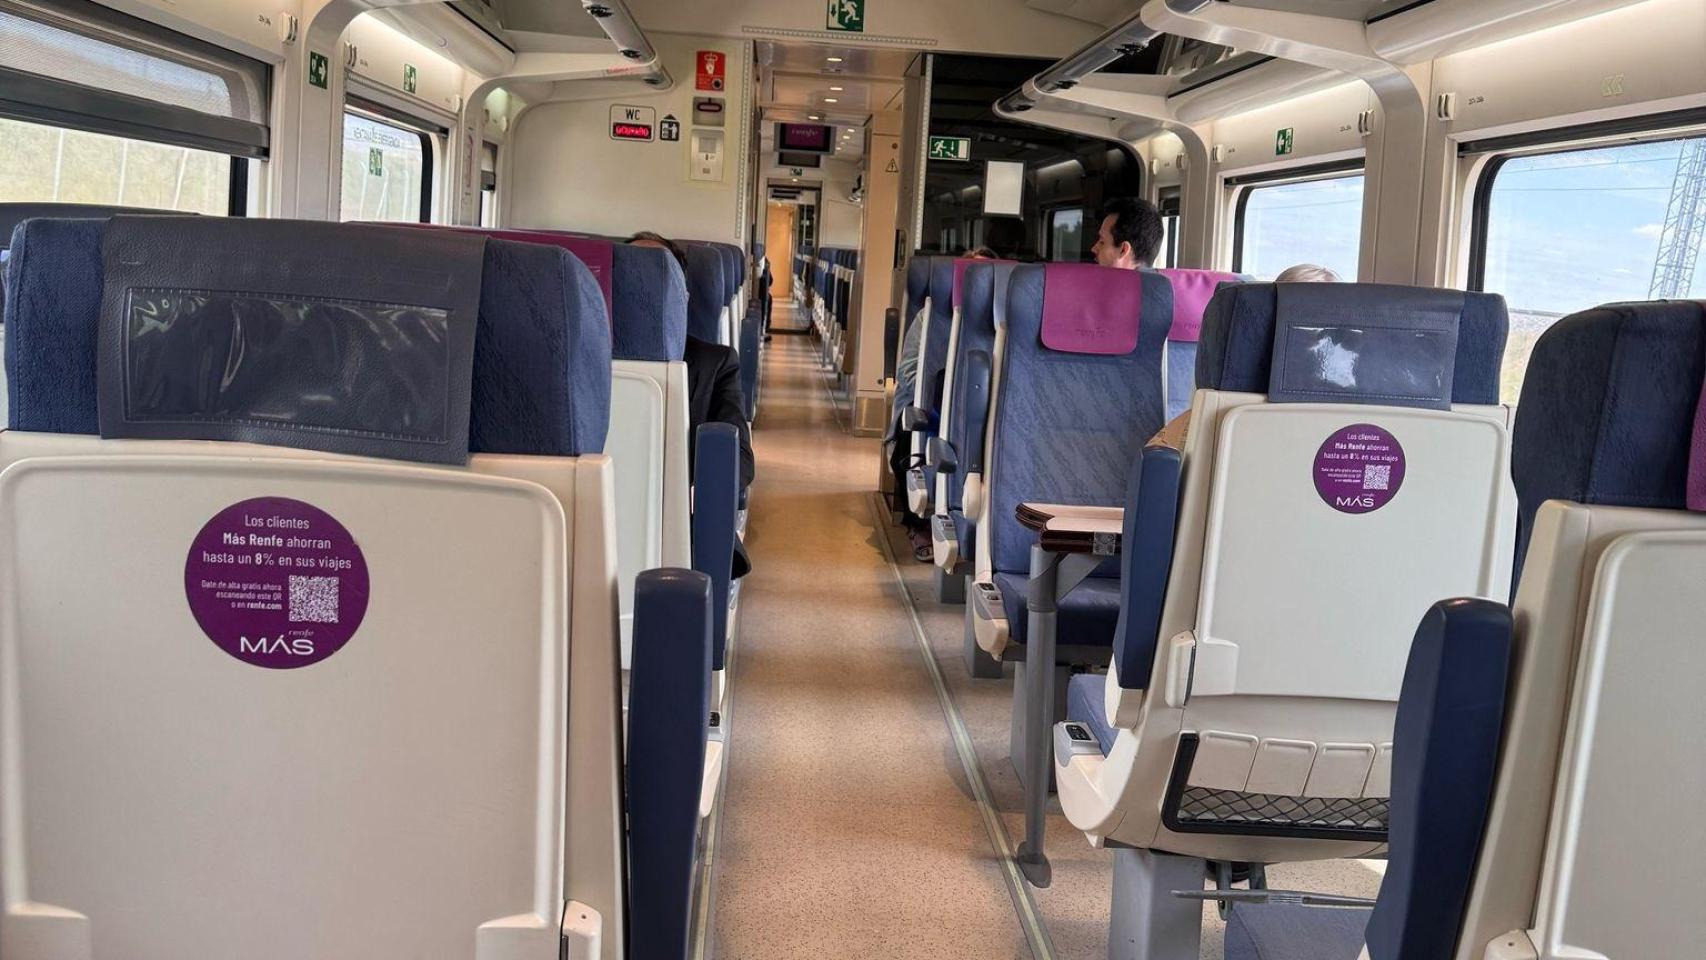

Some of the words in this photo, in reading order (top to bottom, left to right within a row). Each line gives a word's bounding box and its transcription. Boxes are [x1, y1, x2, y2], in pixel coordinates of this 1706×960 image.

[625, 108, 641, 120] WC
[1336, 496, 1375, 507] MÁS
[245, 515, 264, 527] Los
[266, 516, 310, 530] clientes
[223, 532, 246, 545] Más
[249, 534, 284, 547] Renfe
[286, 536, 332, 549] ahorran
[203, 551, 234, 564] hasta
[238, 554, 252, 565] un
[255, 553, 275, 566] 8%
[278, 556, 293, 567] en
[296, 557, 316, 569] sus
[318, 557, 352, 572] viajes
[218, 581, 227, 589] de
[246, 601, 282, 610] renfe.com
[240, 635, 314, 656] MÁS
